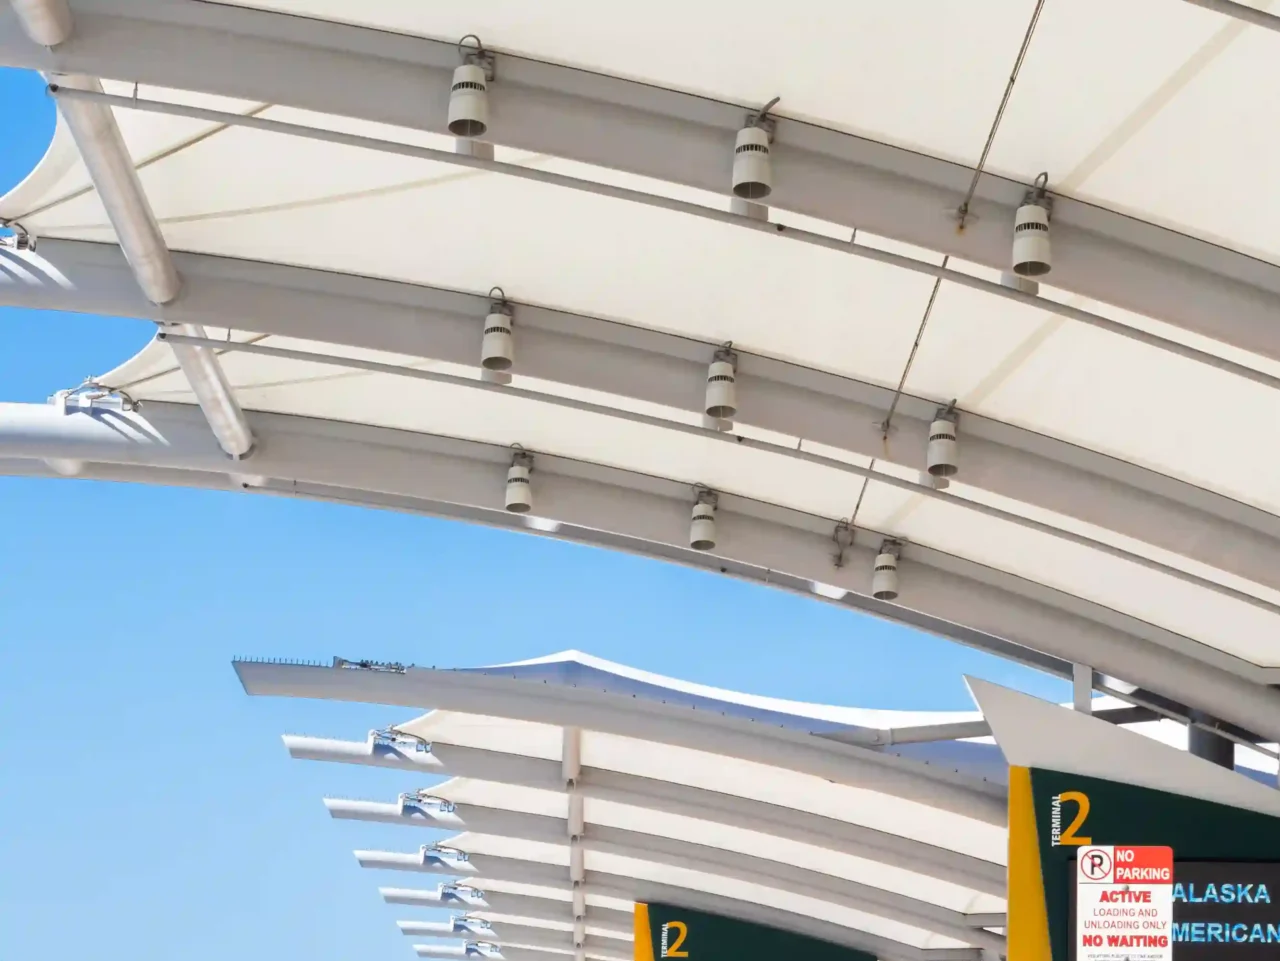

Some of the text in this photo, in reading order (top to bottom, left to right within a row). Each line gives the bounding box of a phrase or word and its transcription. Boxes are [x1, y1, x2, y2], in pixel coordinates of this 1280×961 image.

[1052, 794, 1061, 847] TERMINAL
[1060, 791, 1091, 845] 2
[1116, 850, 1134, 862] NO
[1116, 868, 1170, 879] PARKING
[1099, 890, 1151, 903] ACTIVE
[1172, 883, 1270, 903] ALASKA
[1093, 908, 1158, 917] LOADING AND
[1084, 920, 1167, 929] UNLOADING ONLY
[661, 922, 669, 958] TERMINAL
[667, 921, 688, 957] 2
[1082, 935, 1168, 947] NO WAITING
